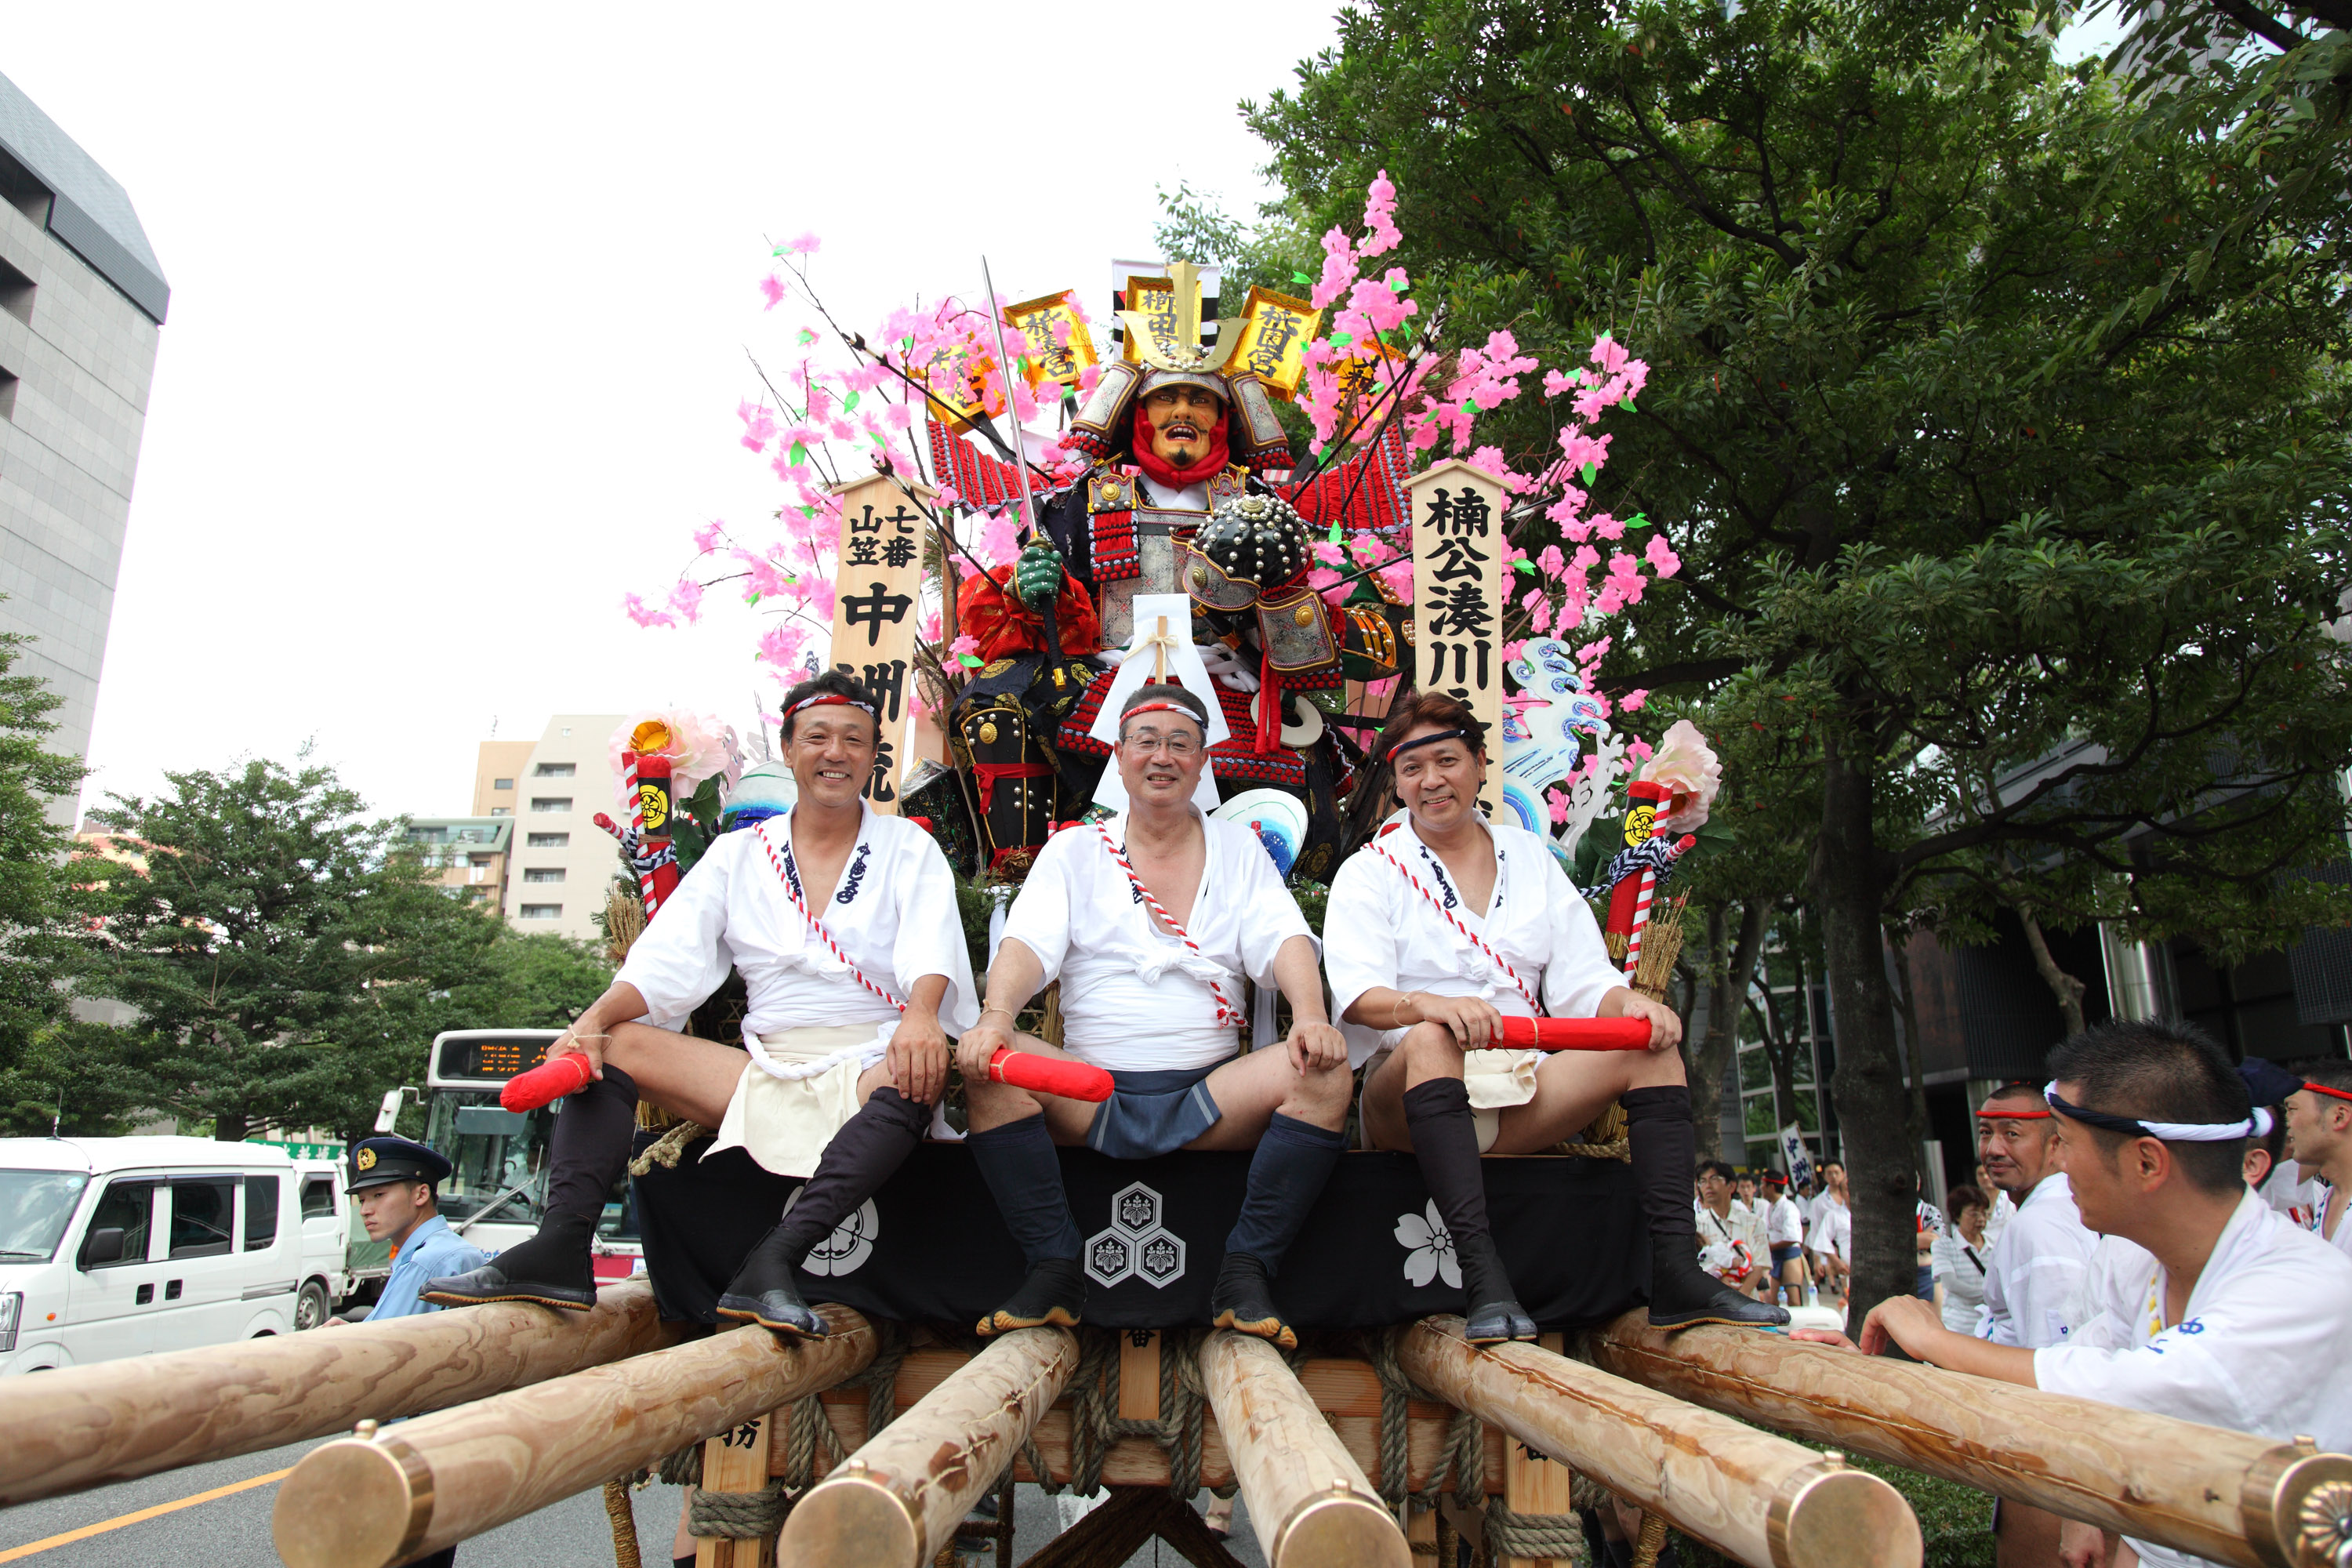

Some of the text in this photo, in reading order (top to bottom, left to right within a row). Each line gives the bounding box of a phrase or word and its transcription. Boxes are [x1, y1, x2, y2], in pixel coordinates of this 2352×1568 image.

[845, 505, 884, 567] 山笠
[880, 505, 920, 568] 七番
[1422, 487, 1494, 820] 楠公湊川
